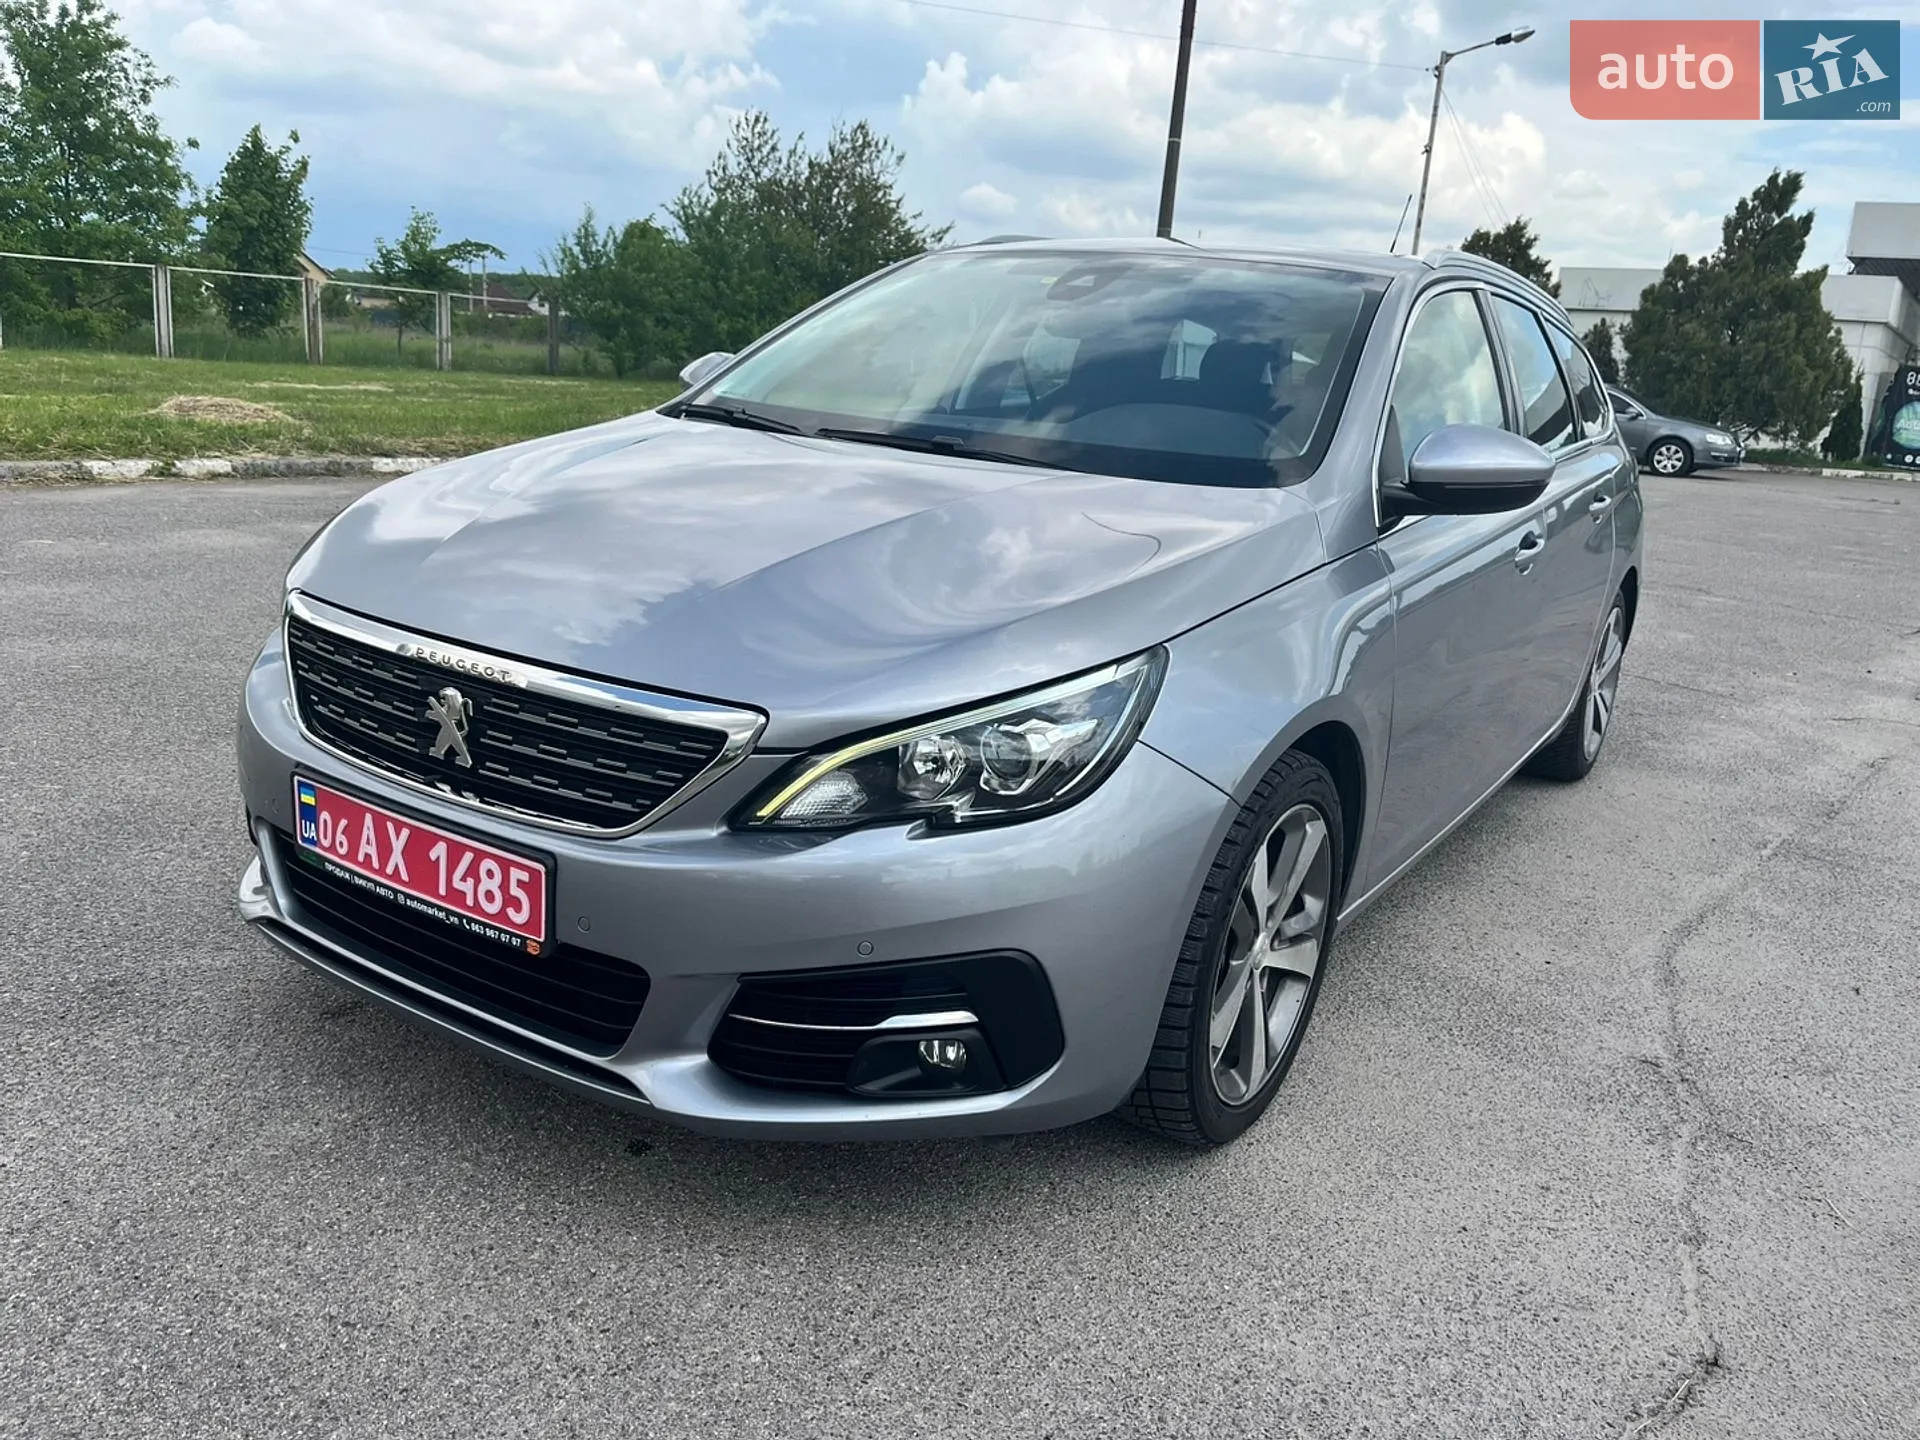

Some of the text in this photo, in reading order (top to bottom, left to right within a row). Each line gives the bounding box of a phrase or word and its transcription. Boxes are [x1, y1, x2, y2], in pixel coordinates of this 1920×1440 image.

[415, 646, 511, 682] PEUGEOT
[302, 819, 318, 841] UA
[319, 811, 531, 925] 06 AX 1485
